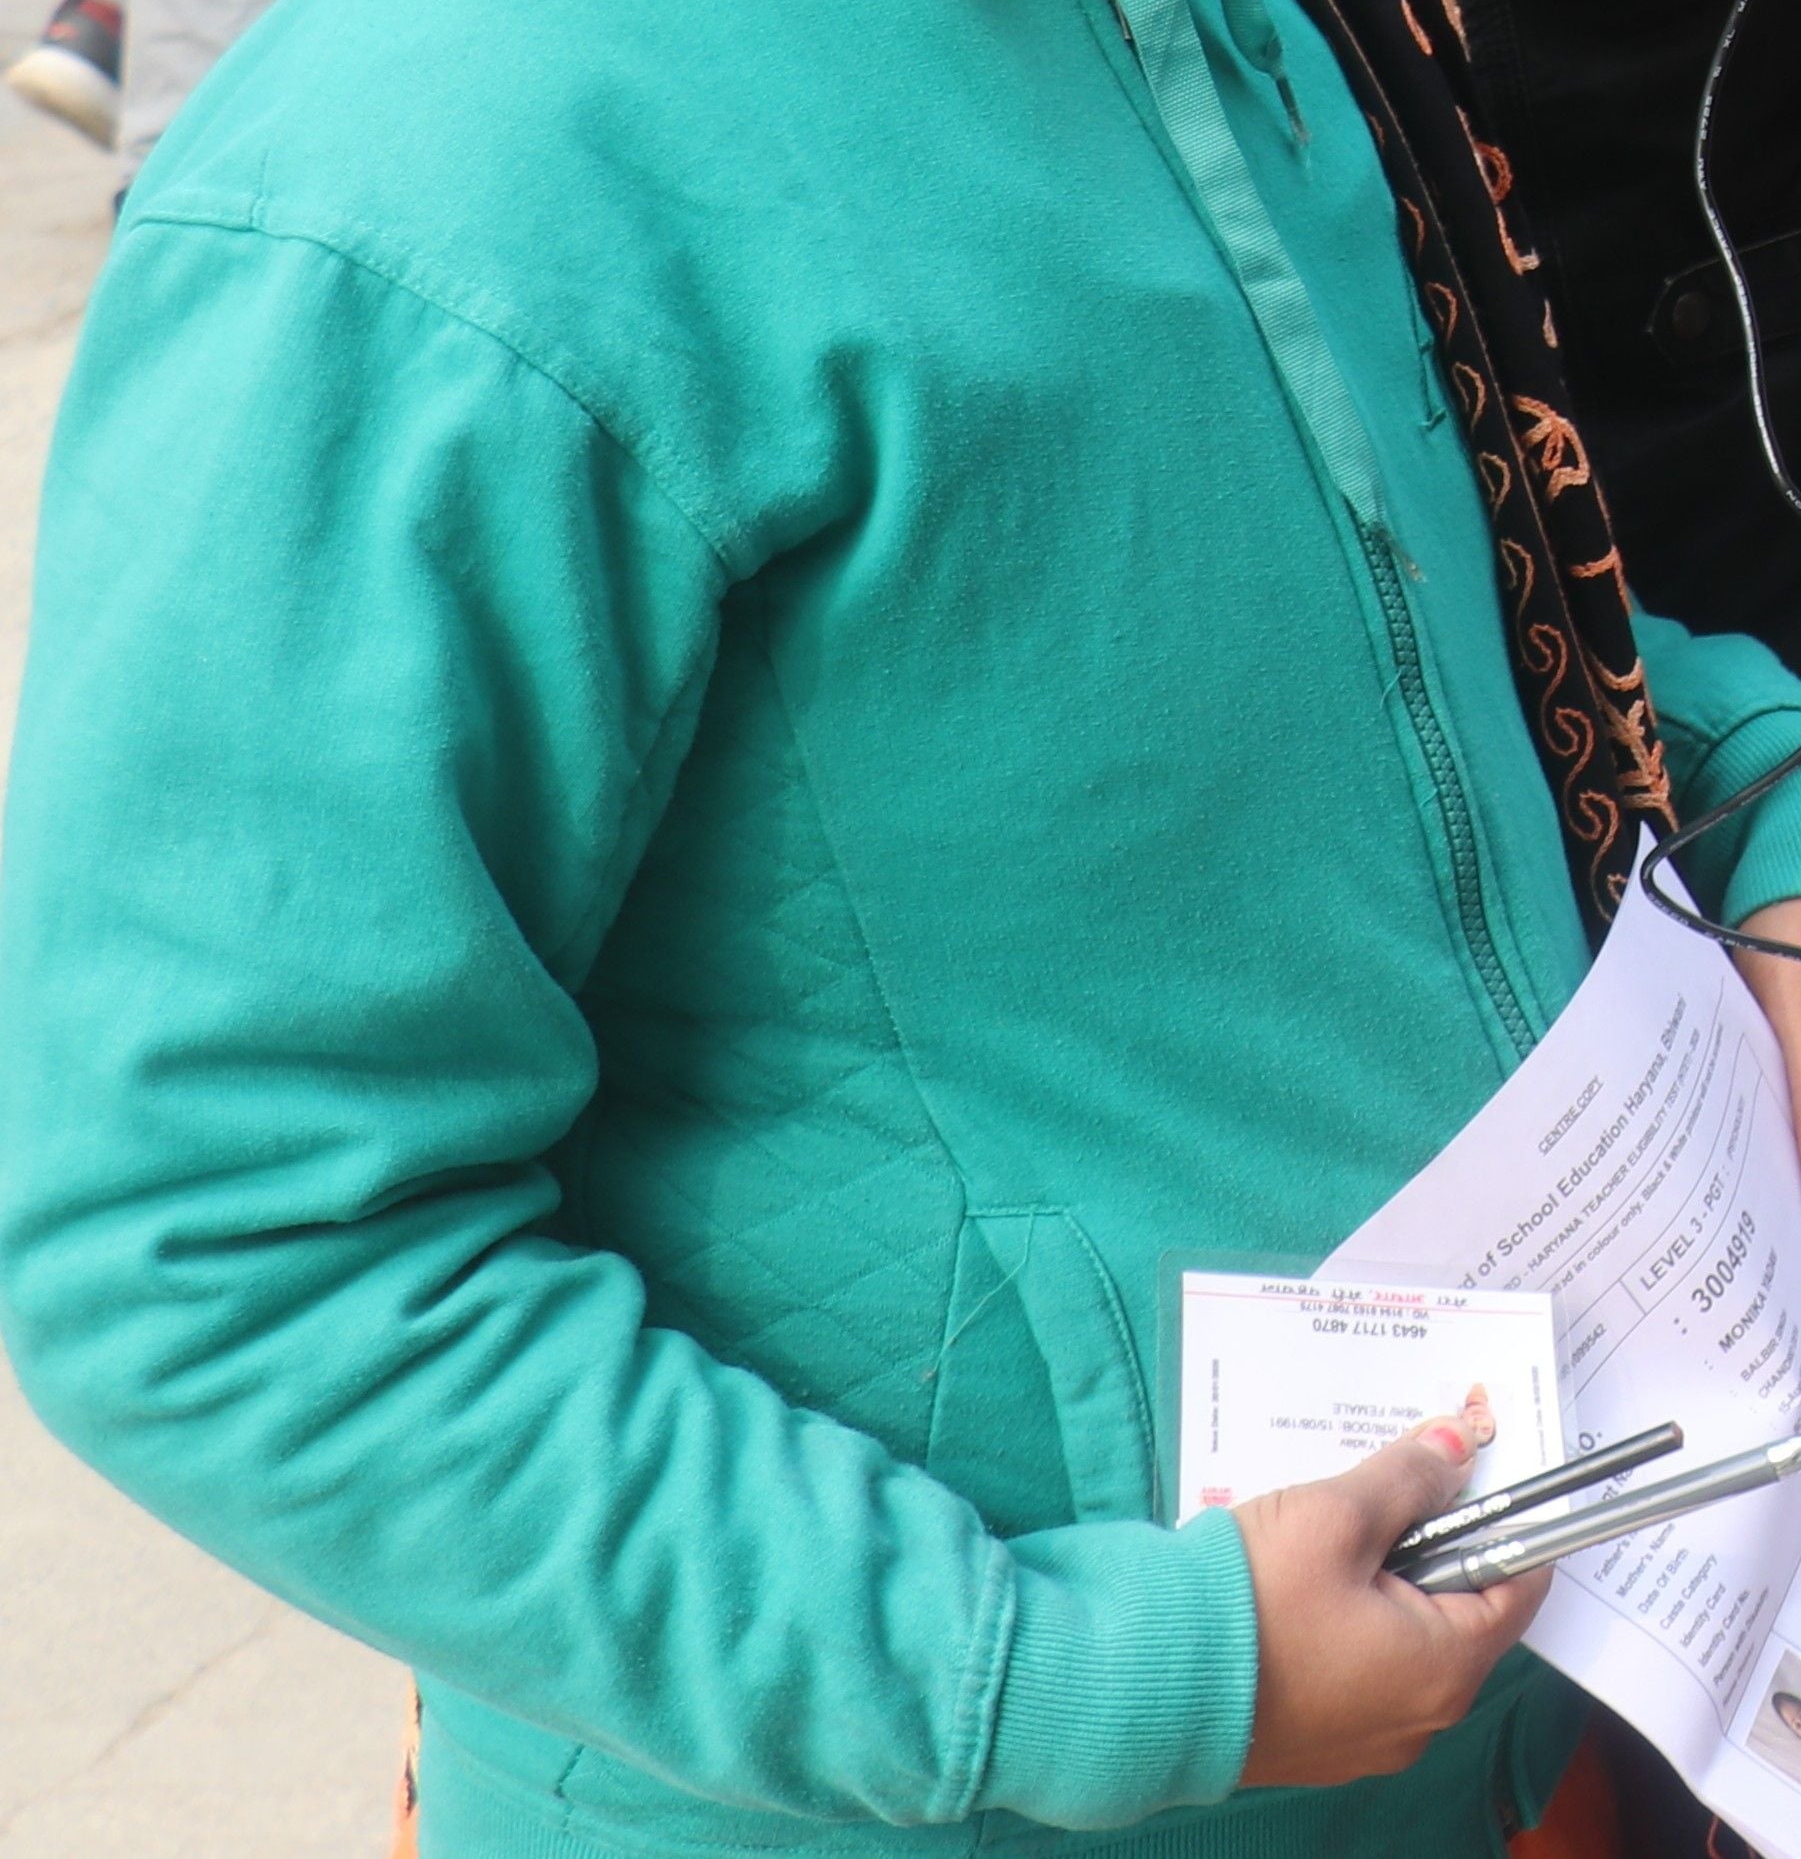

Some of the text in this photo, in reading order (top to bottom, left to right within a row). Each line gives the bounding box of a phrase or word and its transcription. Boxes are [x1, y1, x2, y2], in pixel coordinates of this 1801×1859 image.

[1536, 1074, 1603, 1156] CENTRE COPY
[1476, 1251, 1497, 1278] of
[1494, 1192, 1560, 1257] School
[1555, 1110, 1631, 1198] Education
[1527, 1216, 1584, 1272] HARYANA
[1580, 1162, 1630, 1218] TEACHER
[1585, 1222, 1622, 1263] colour
[1639, 1167, 1665, 1202] Black
[1638, 1232, 1696, 1292] LEVEL
[1687, 1216, 1704, 1234] 3
[1704, 1171, 1726, 1212] PGT
[1688, 1209, 1758, 1315] 3004919
[1311, 1317, 1427, 1339] 4643 1717 4870
[1716, 1289, 1768, 1353] MONIKA
[1739, 1334, 1780, 1382] BALBIR
[1269, 1417, 1332, 1430] 15/08/1991
[1332, 1403, 1384, 1416] FEMALE
[1339, 1437, 1375, 1451] Yadav
[1592, 1536, 1631, 1583] Father's
[1614, 1519, 1676, 1599] Mother's Name
[1635, 1545, 1690, 1616] Date Of Birth
[1657, 1552, 1717, 1631] Caste Category
[1679, 1581, 1727, 1649] Identity Card
